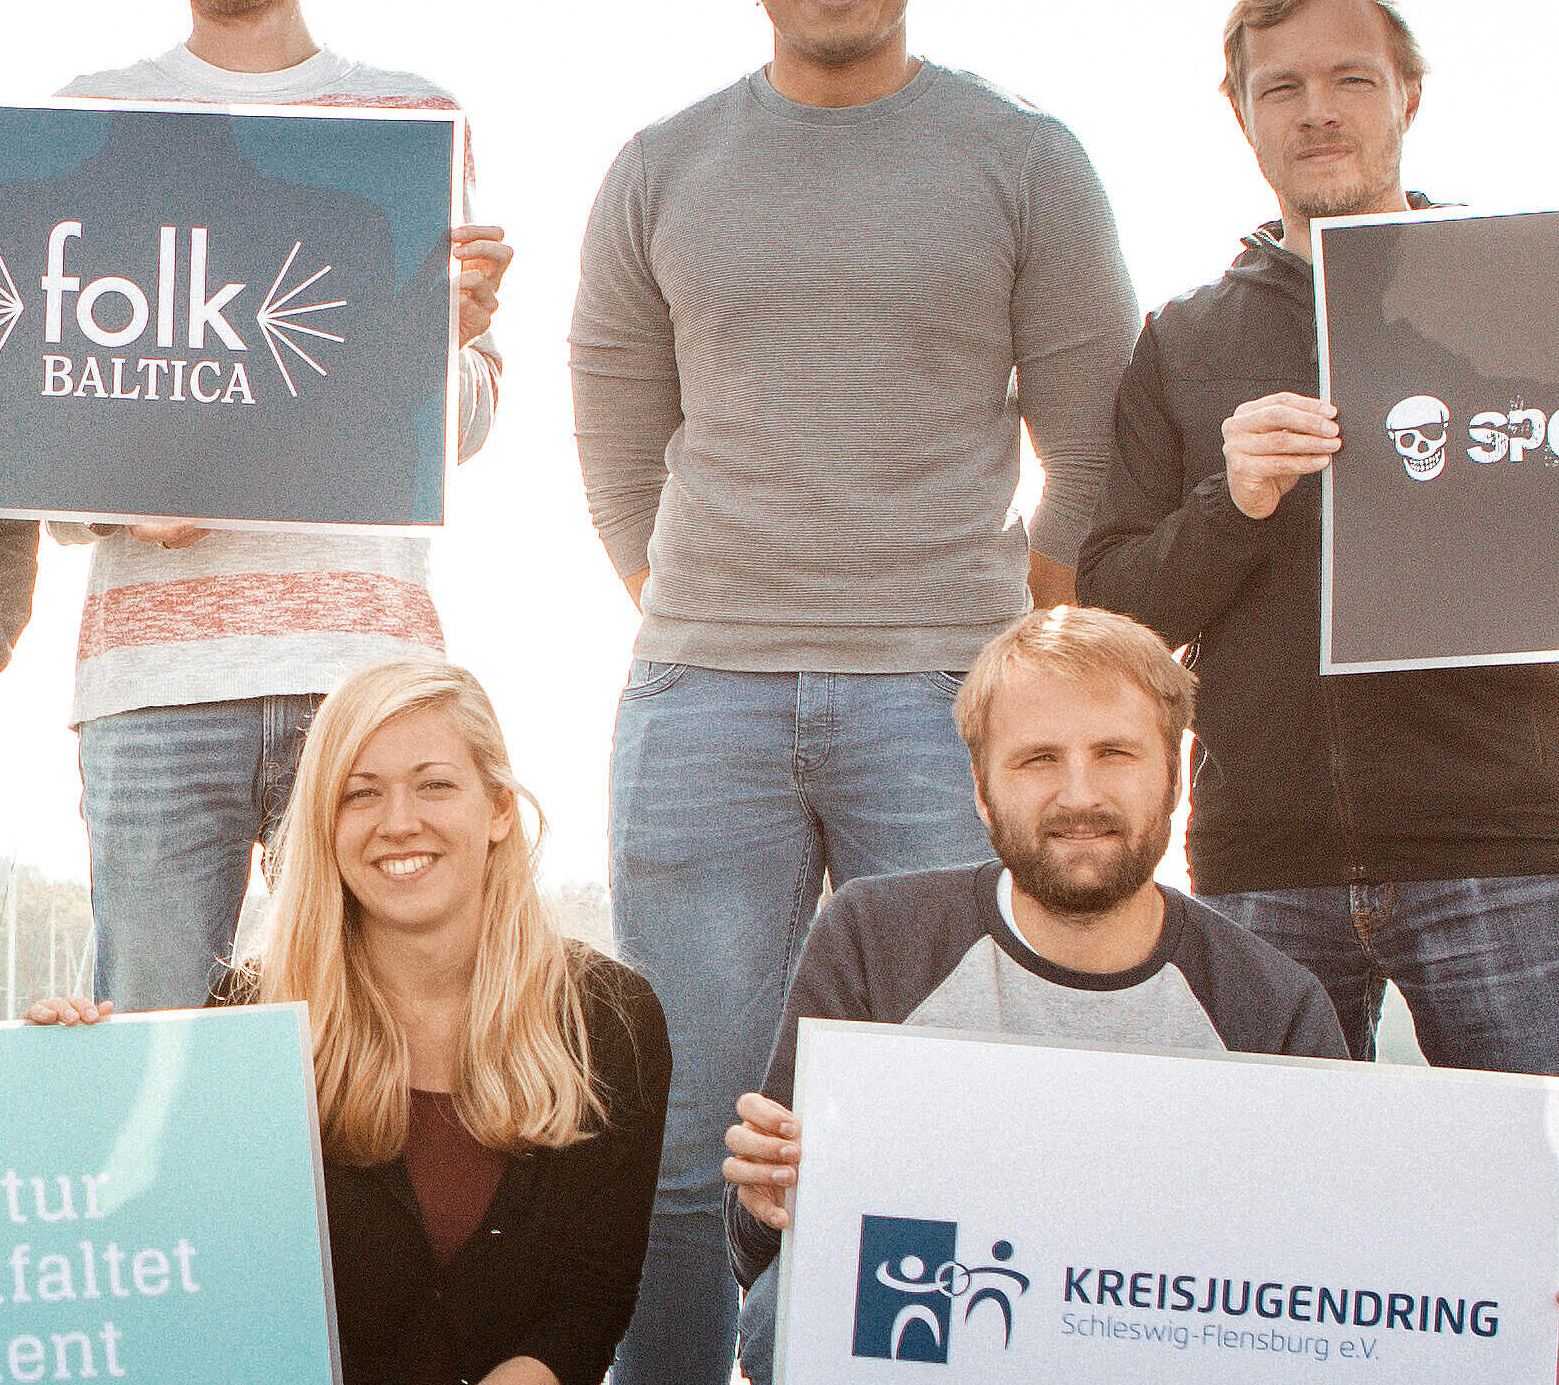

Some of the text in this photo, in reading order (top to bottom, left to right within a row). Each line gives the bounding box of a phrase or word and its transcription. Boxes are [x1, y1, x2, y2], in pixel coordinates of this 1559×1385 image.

[41, 220, 247, 351] folk
[41, 354, 256, 405] BALTICA
[1063, 1266, 1501, 1338] KREISJUGENDRING
[1061, 1313, 1379, 1361] Schleswig-Flensburg e.V.
